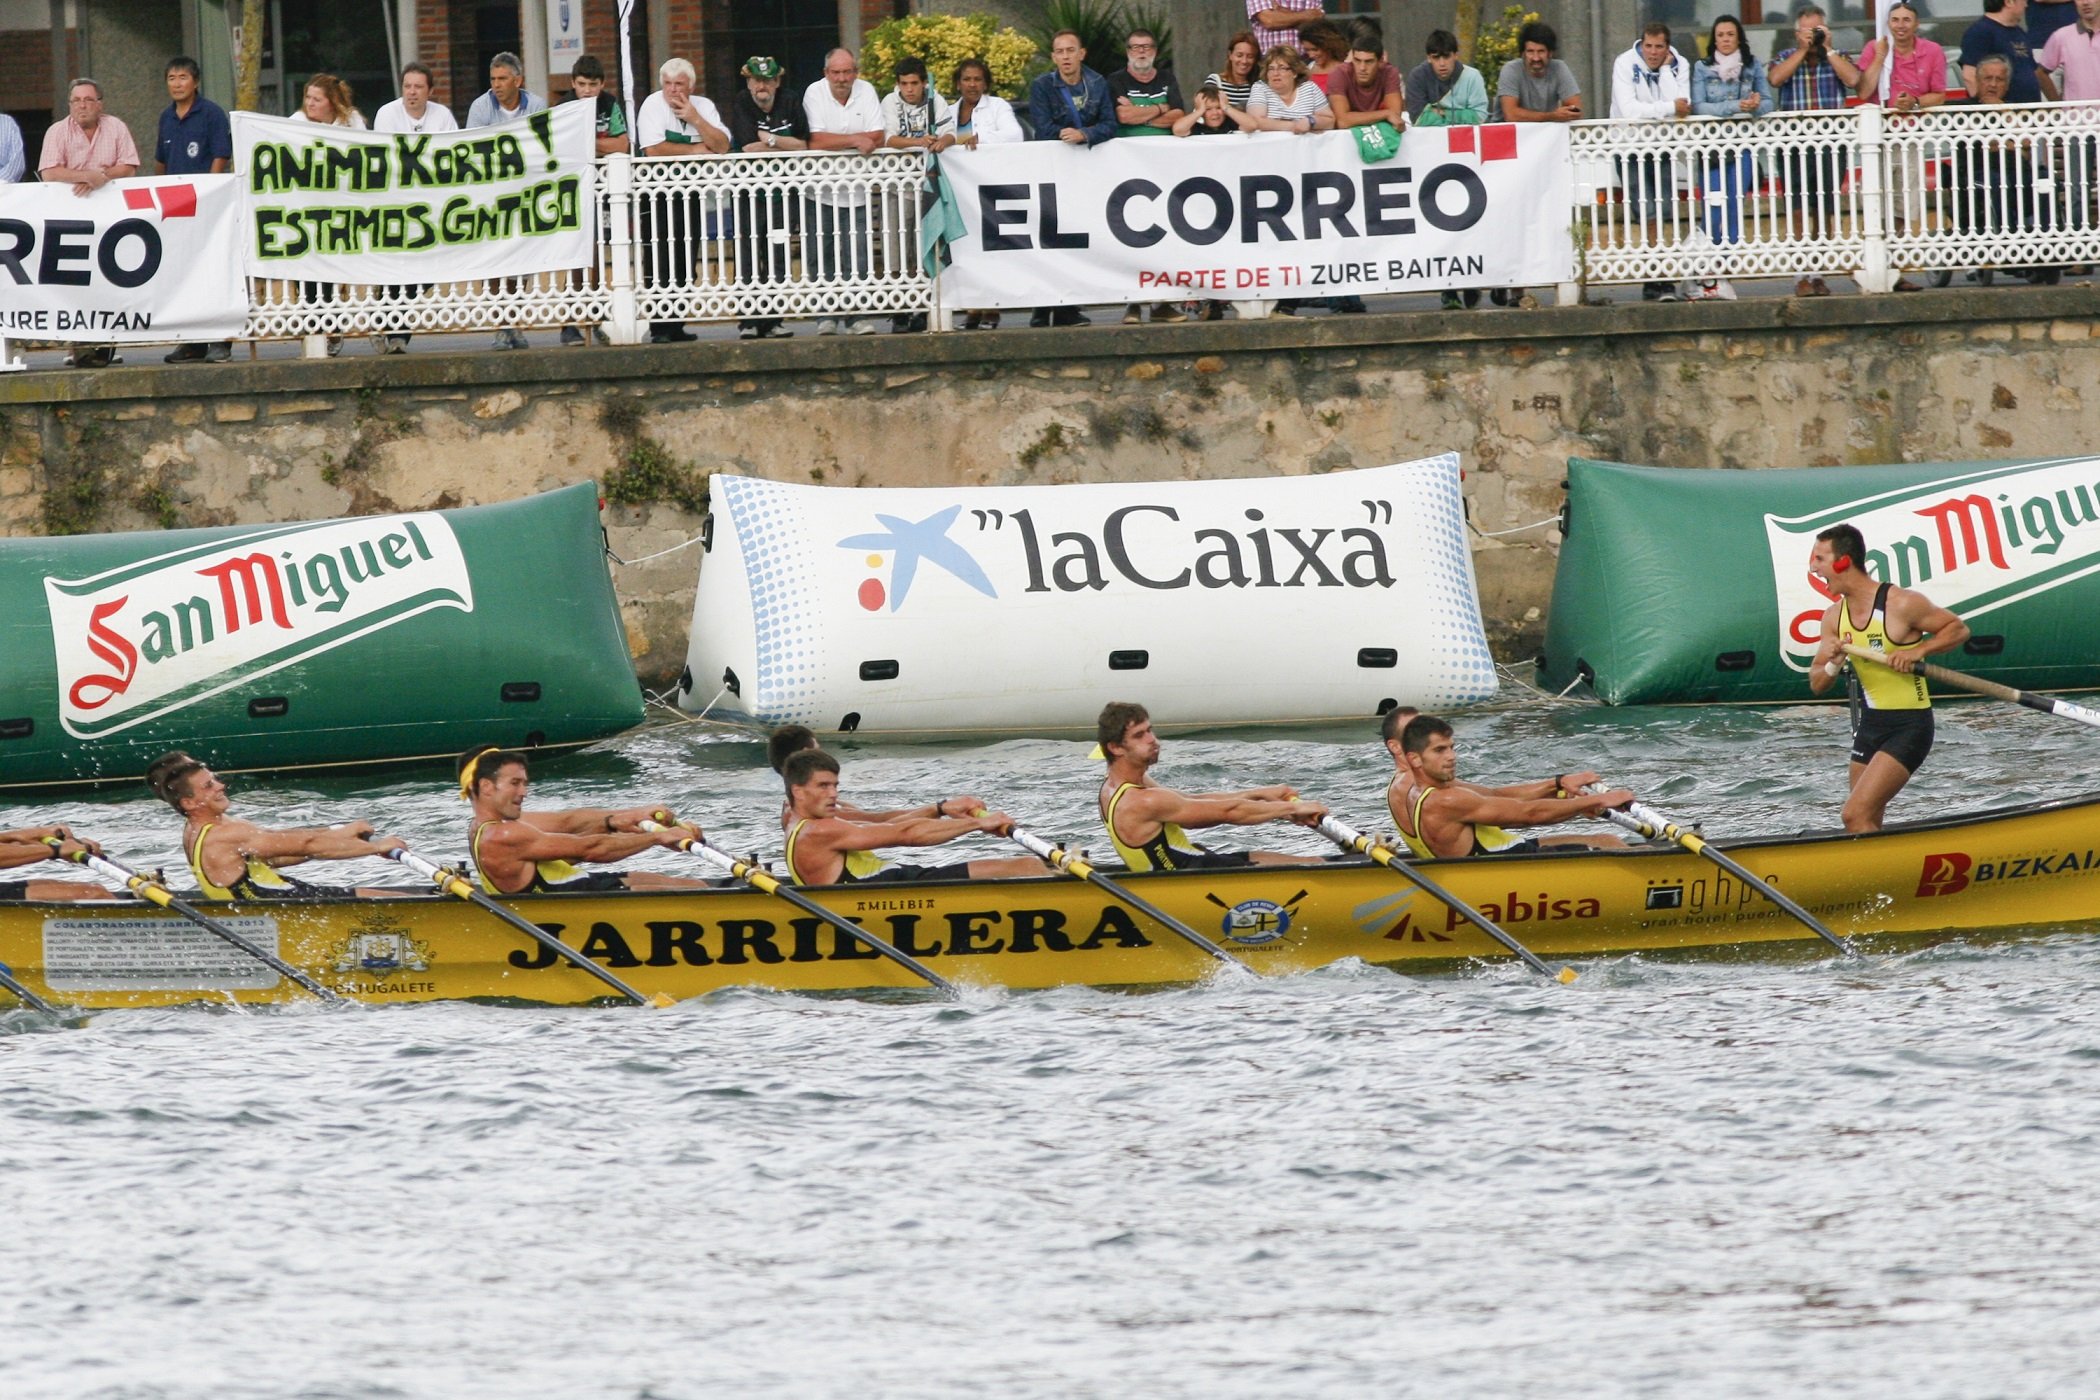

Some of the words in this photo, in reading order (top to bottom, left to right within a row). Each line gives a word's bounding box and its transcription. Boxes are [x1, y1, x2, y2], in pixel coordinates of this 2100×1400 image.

[978, 182, 1090, 251] EL
[1106, 162, 1488, 249] CORREO
[254, 203, 437, 260] ESTAMOS
[1138, 268, 1227, 290] PARTE
[1236, 267, 1270, 288] DE
[1279, 265, 1301, 286] TI
[1311, 262, 1380, 285] ZURE
[1387, 255, 1484, 281] BAITAN
[0, 310, 48, 330] URE
[56, 310, 152, 330] BAITAN
[1974, 850, 2100, 882] BIZKAI
[54, 921, 157, 929] COLABORADORES
[238, 919, 266, 927] 2013
[508, 904, 1153, 969] JARRILLERA
[1641, 918, 1678, 929] gran
[1684, 913, 1728, 925] hotel
